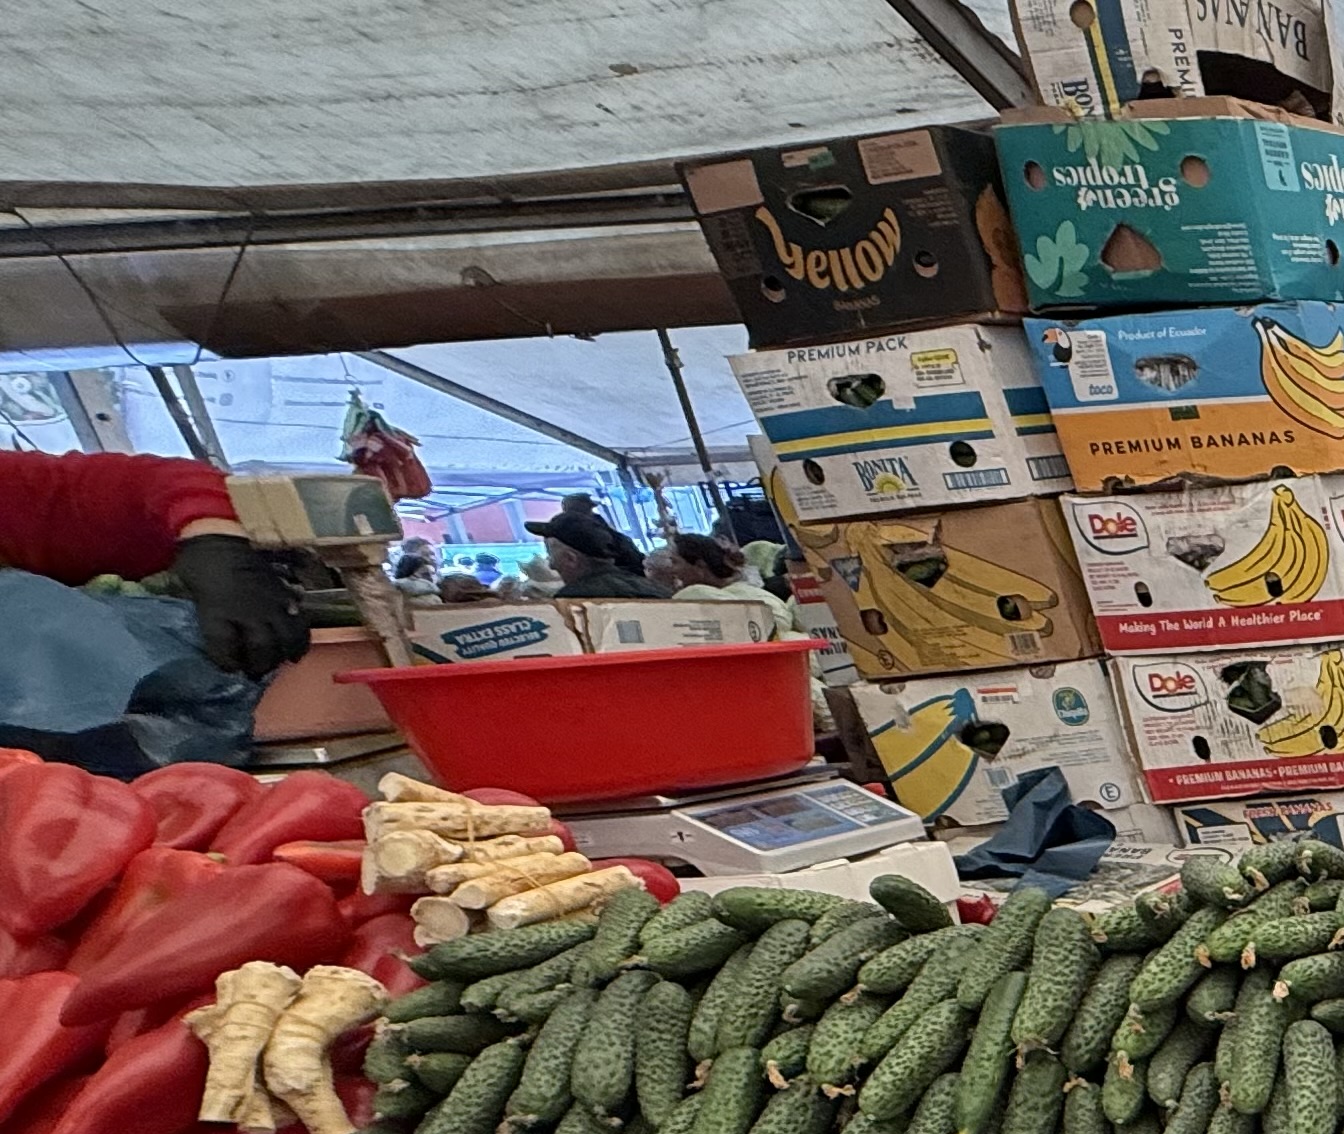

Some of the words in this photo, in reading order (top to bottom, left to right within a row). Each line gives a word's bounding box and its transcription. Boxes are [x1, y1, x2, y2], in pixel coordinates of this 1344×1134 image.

[1168, 28, 1197, 97] PREMI
[1061, 77, 1096, 119] BON
[1052, 157, 1148, 190] tropics
[1118, 329, 1154, 341] Product
[1156, 328, 1167, 339] of
[787, 343, 860, 364] PREMIUM
[866, 336, 908, 353] PACK
[1090, 437, 1181, 455] PREMIUM
[1191, 430, 1295, 449] BANANAS
[852, 456, 918, 491] BONITA
[1088, 511, 1138, 535] Dole
[1119, 620, 1157, 636] Making
[1160, 619, 1180, 631] The
[1183, 616, 1213, 630] World
[1218, 616, 1226, 627] A
[1231, 611, 1285, 627] Healthier
[1289, 610, 1321, 623] Place
[1149, 672, 1195, 693] Dole
[1176, 771, 1224, 786] PREMIUM
[1226, 768, 1273, 781] BANANAS
[1278, 763, 1327, 778] PREMIUM
